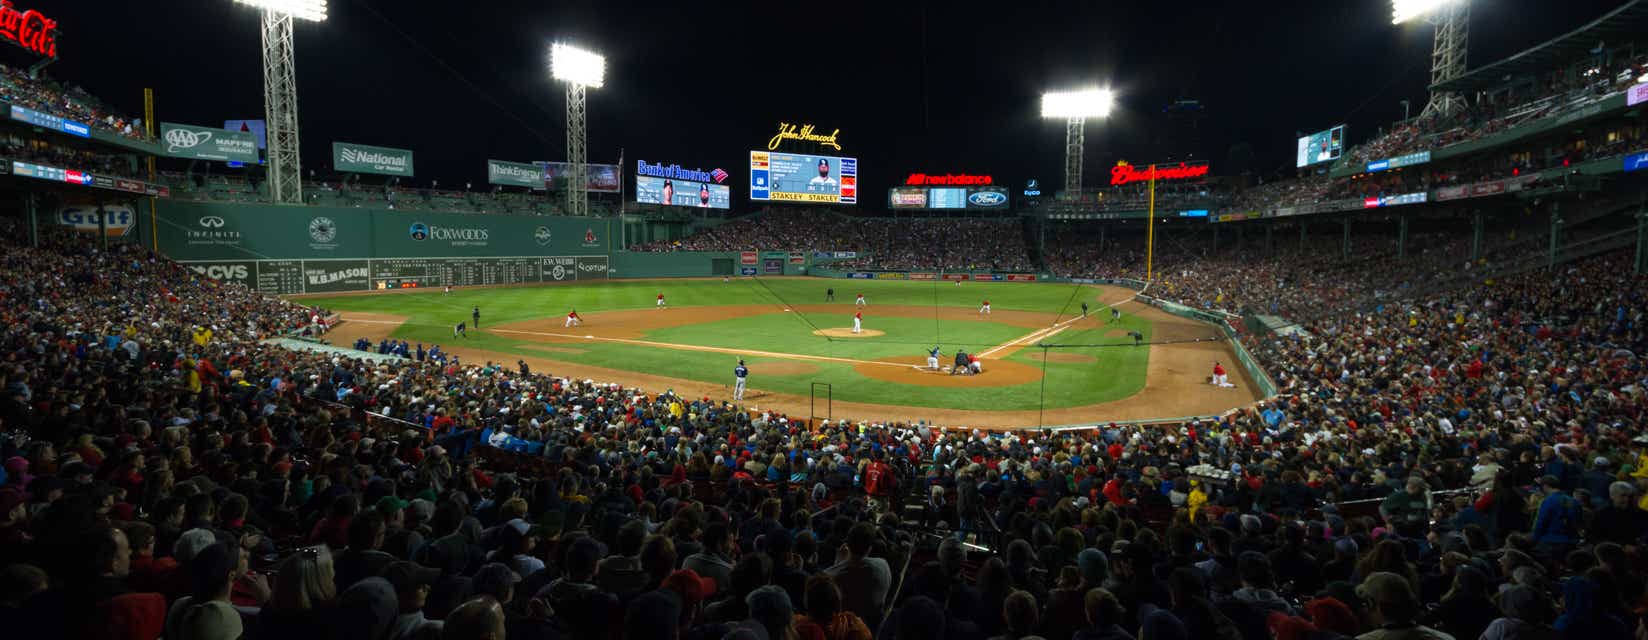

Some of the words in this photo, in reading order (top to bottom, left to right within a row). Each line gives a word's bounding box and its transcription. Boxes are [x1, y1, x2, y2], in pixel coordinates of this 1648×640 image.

[167, 129, 198, 147] AAA
[768, 122, 798, 151] John
[800, 124, 842, 151] Hancock
[356, 151, 406, 166] National
[492, 164, 541, 180] ThinkEnergy
[637, 159, 664, 177] Bank
[664, 163, 675, 178] of
[675, 165, 711, 182] America
[1110, 162, 1209, 185] Budweiser
[925, 176, 948, 185] new
[948, 173, 992, 185] balance
[975, 193, 999, 203] Ford
[63, 207, 130, 225] Gulf
[429, 225, 489, 240] FOXWOODS
[207, 265, 249, 280] CVS
[585, 264, 607, 272] OPTUM
